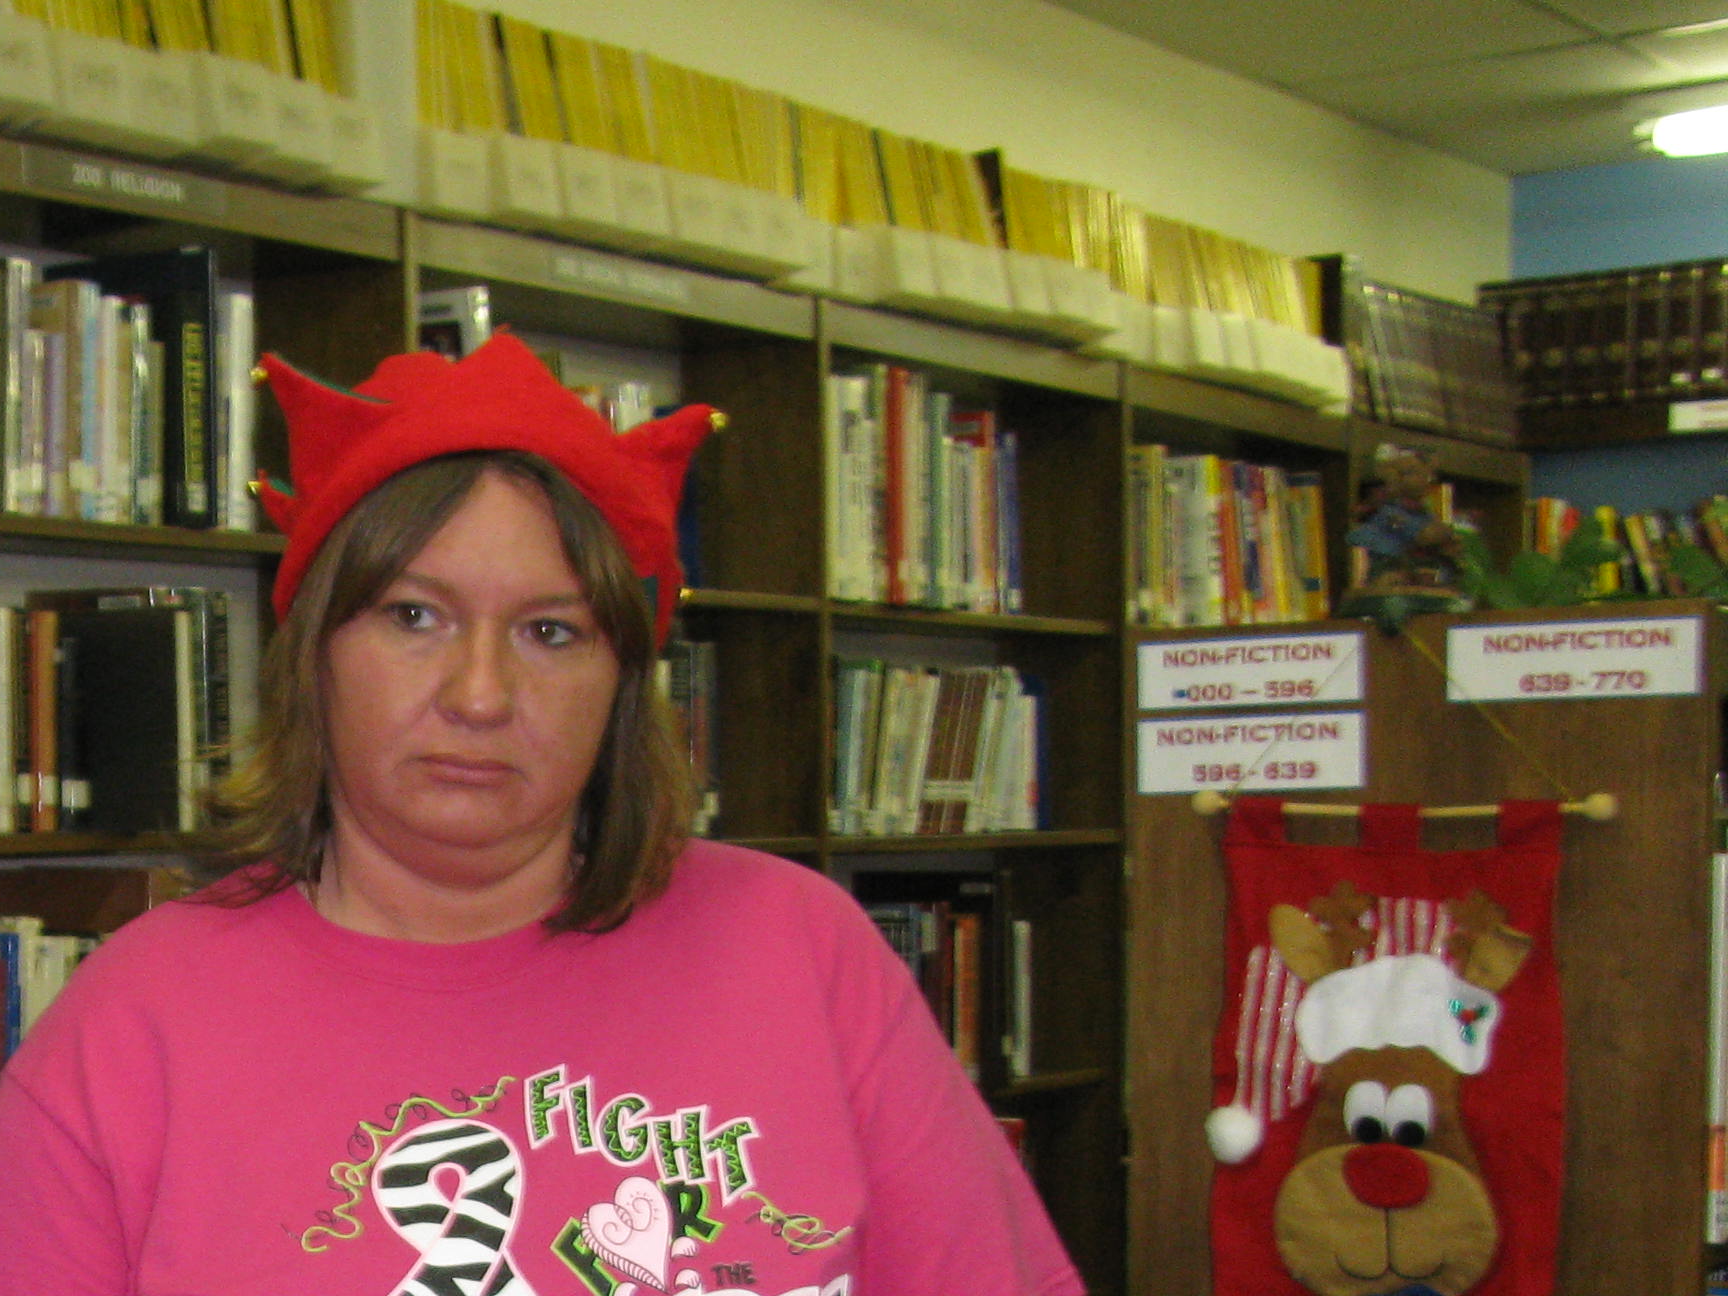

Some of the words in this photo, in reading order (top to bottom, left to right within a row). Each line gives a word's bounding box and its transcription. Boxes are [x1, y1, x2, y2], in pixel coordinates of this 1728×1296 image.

[1482, 628, 1672, 654] NON-FICTION
[1162, 642, 1333, 668] NON-FICTION
[1264, 679, 1315, 699] 596
[1519, 673, 1571, 693] 639
[1590, 670, 1648, 690] 770
[1156, 722, 1339, 746] NON-FICTION
[1263, 761, 1318, 781] 639
[522, 1062, 760, 1205] FIGHT
[710, 1262, 757, 1286] THE
